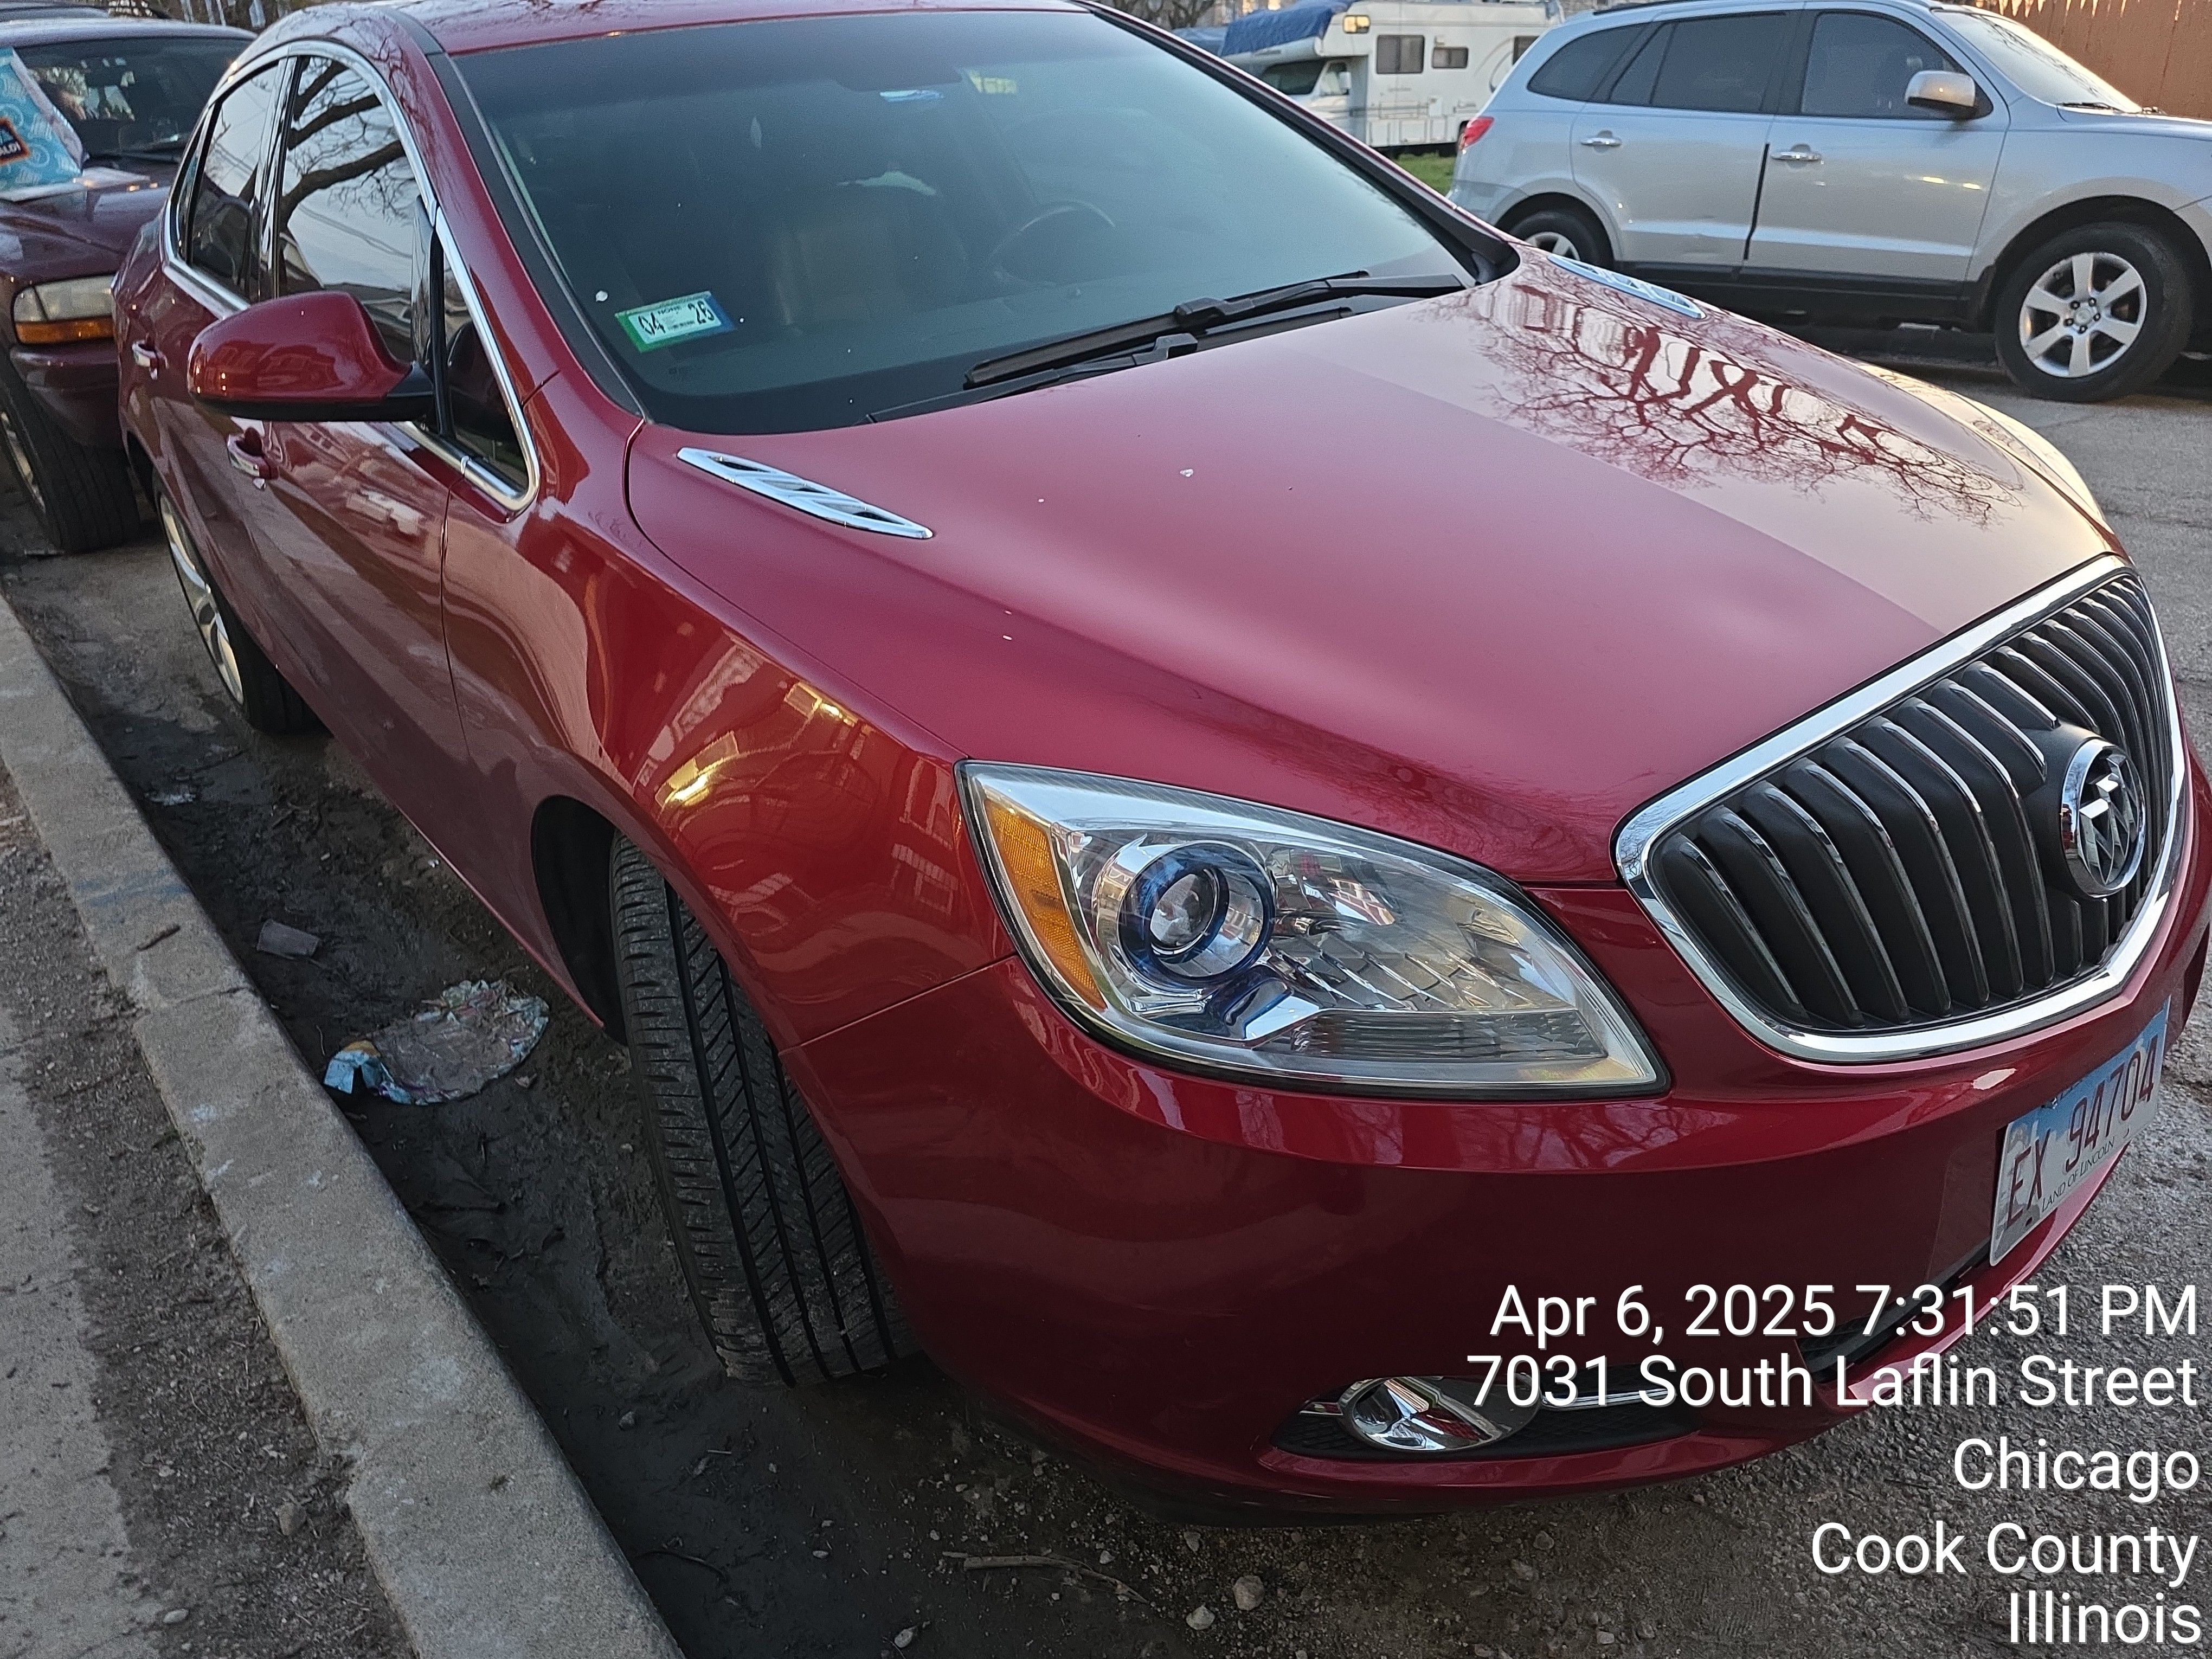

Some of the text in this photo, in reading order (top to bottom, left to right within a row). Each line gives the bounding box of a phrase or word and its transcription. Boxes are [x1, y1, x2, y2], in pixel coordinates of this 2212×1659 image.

[638, 312, 666, 336] 04
[2007, 1034, 2159, 1227] EX 94704
[2042, 1136, 2115, 1213] LAND OF LINCOLN
